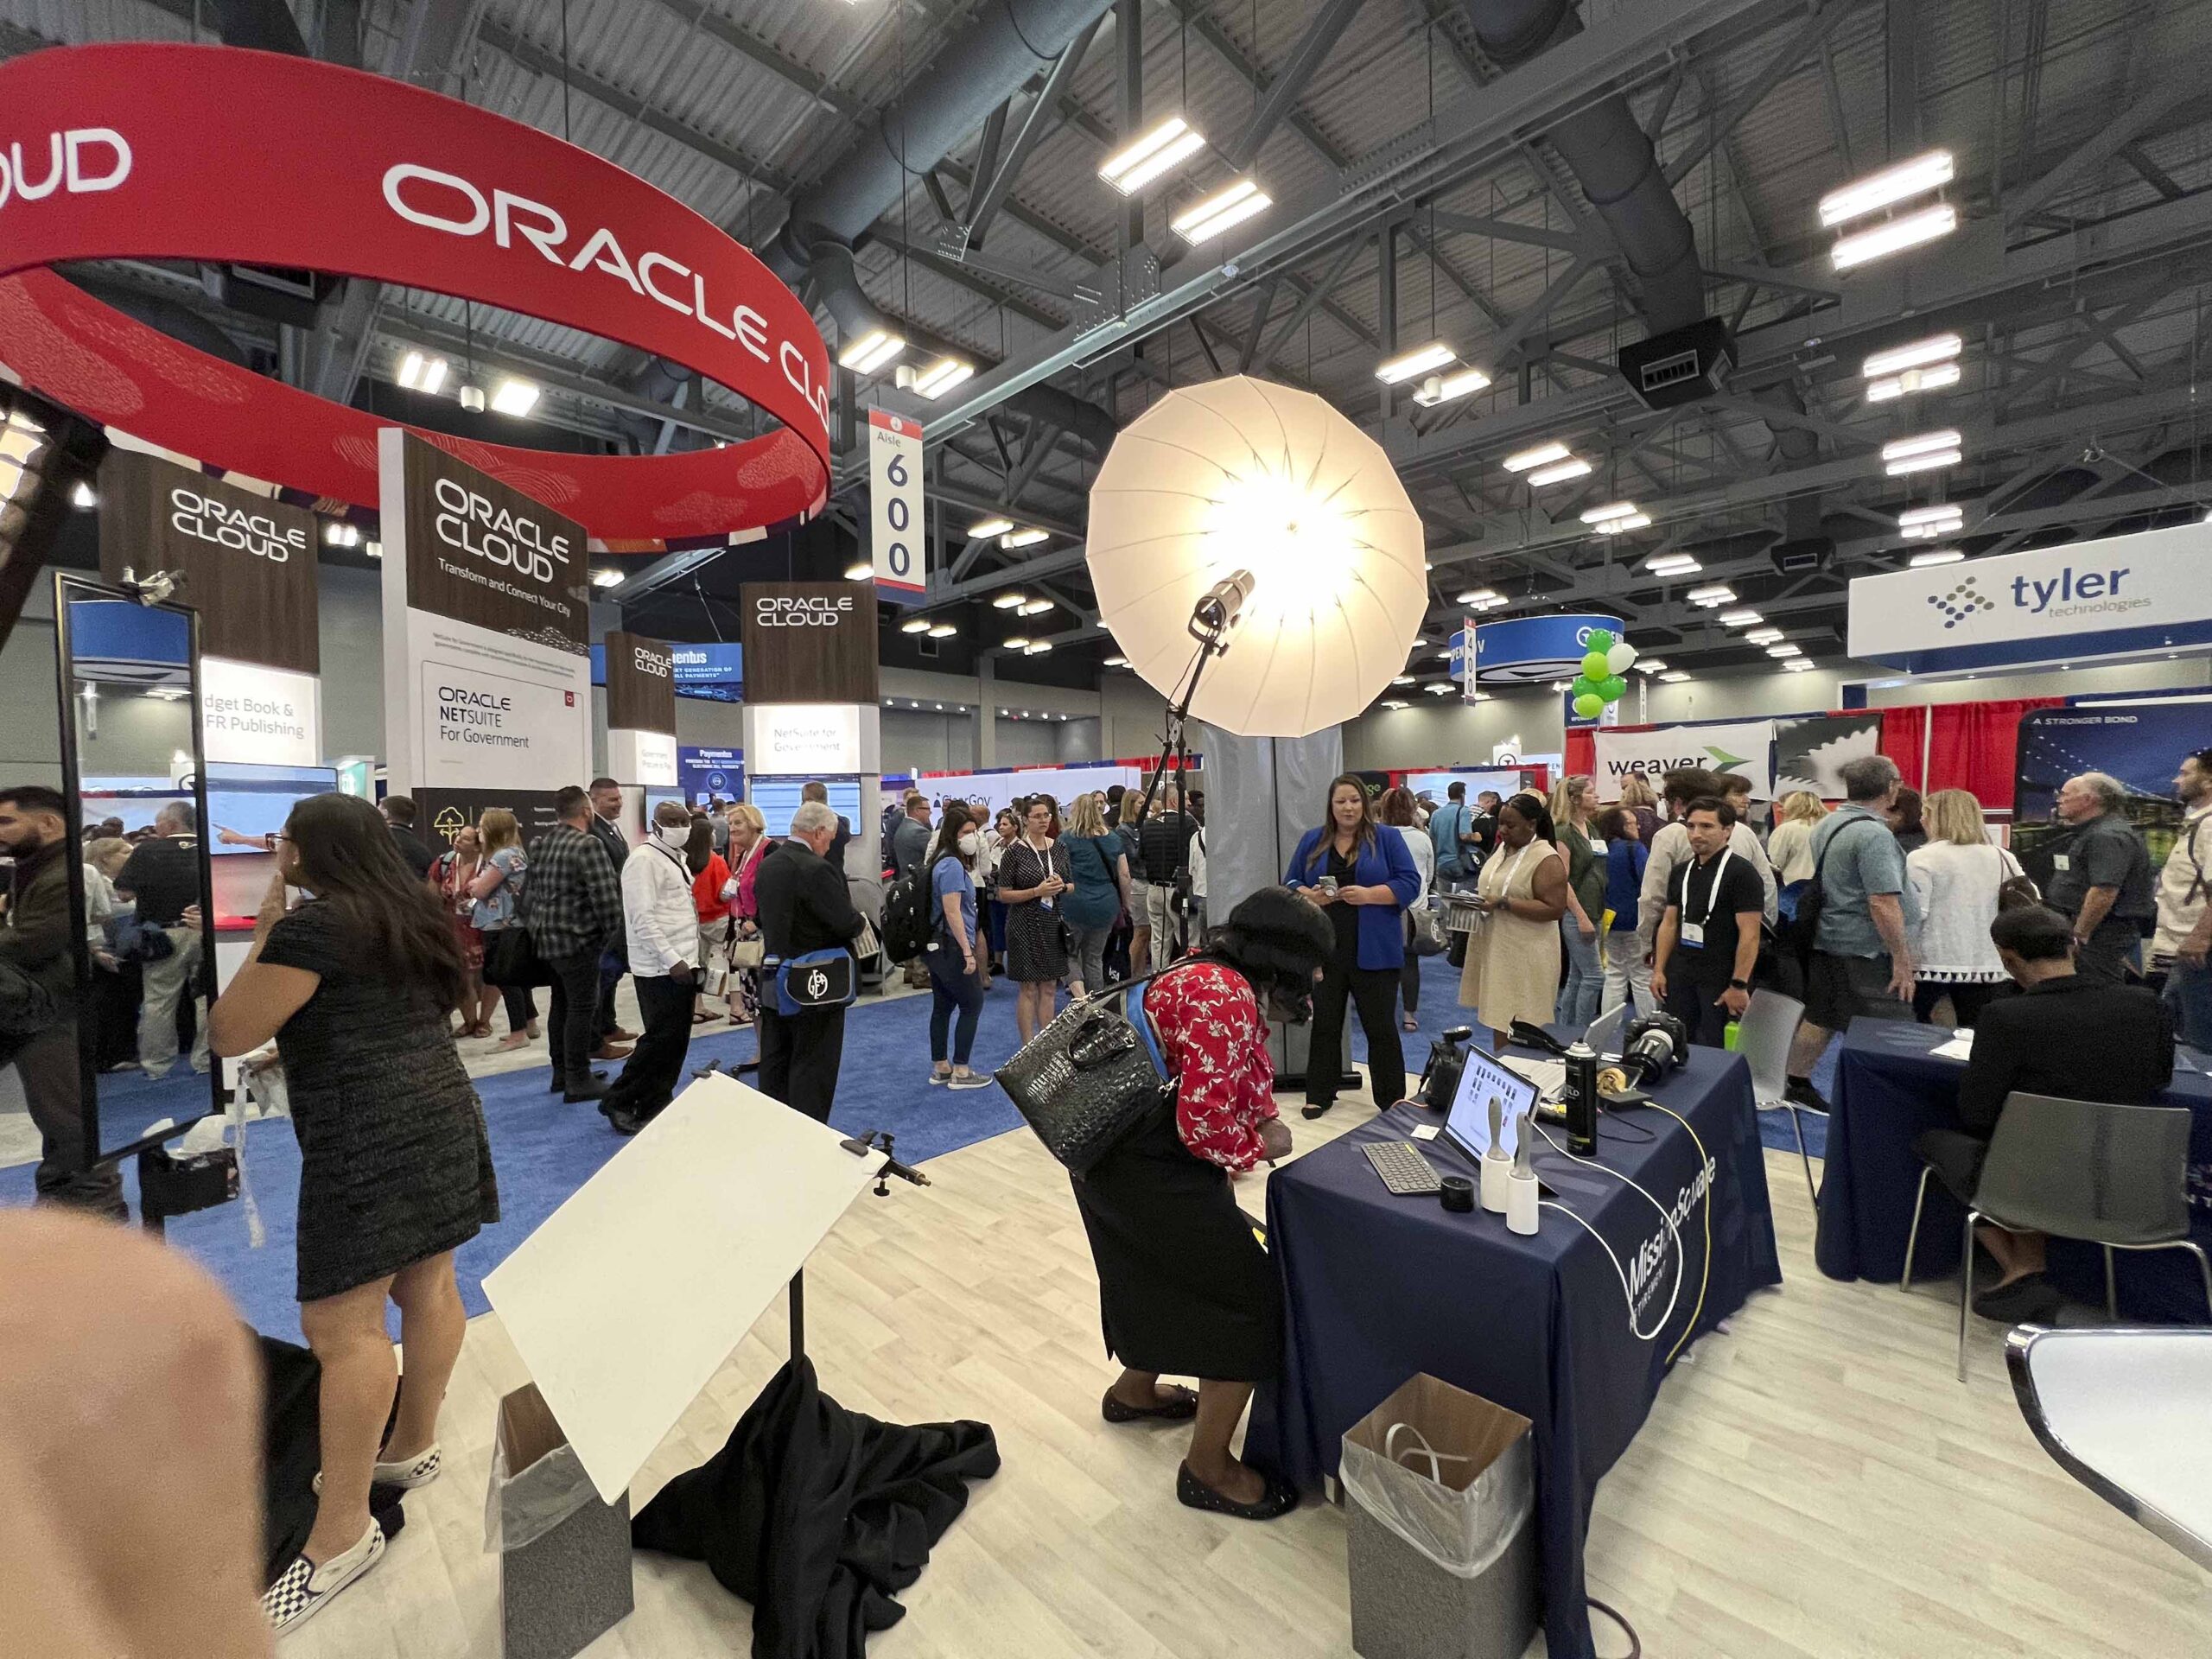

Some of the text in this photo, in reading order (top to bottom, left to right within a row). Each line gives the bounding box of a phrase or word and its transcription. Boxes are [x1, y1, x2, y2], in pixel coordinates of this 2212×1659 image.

[382, 163, 771, 363] ORACLE
[877, 432, 901, 448] Aisle
[171, 488, 306, 549] ORACLE
[435, 478, 570, 564] ORACLE
[172, 512, 289, 563] CLOUD
[435, 513, 554, 583] CLOUD
[438, 557, 571, 617] Transform and Connect Your City
[2011, 568, 2131, 613] tyler
[756, 597, 854, 612] ORACLE
[2049, 596, 2152, 618] technologies
[756, 613, 839, 626] CLOUD
[634, 647, 672, 669] ORACLE
[635, 658, 668, 678] CLOUD
[204, 695, 294, 716] dget Book &
[438, 686, 511, 711] ORACLE
[206, 715, 305, 740] FR Publishing
[440, 706, 502, 728] NETSUITE
[2045, 716, 2102, 725] STRONGER
[2104, 715, 2139, 724] BOND
[441, 726, 530, 748] For Government
